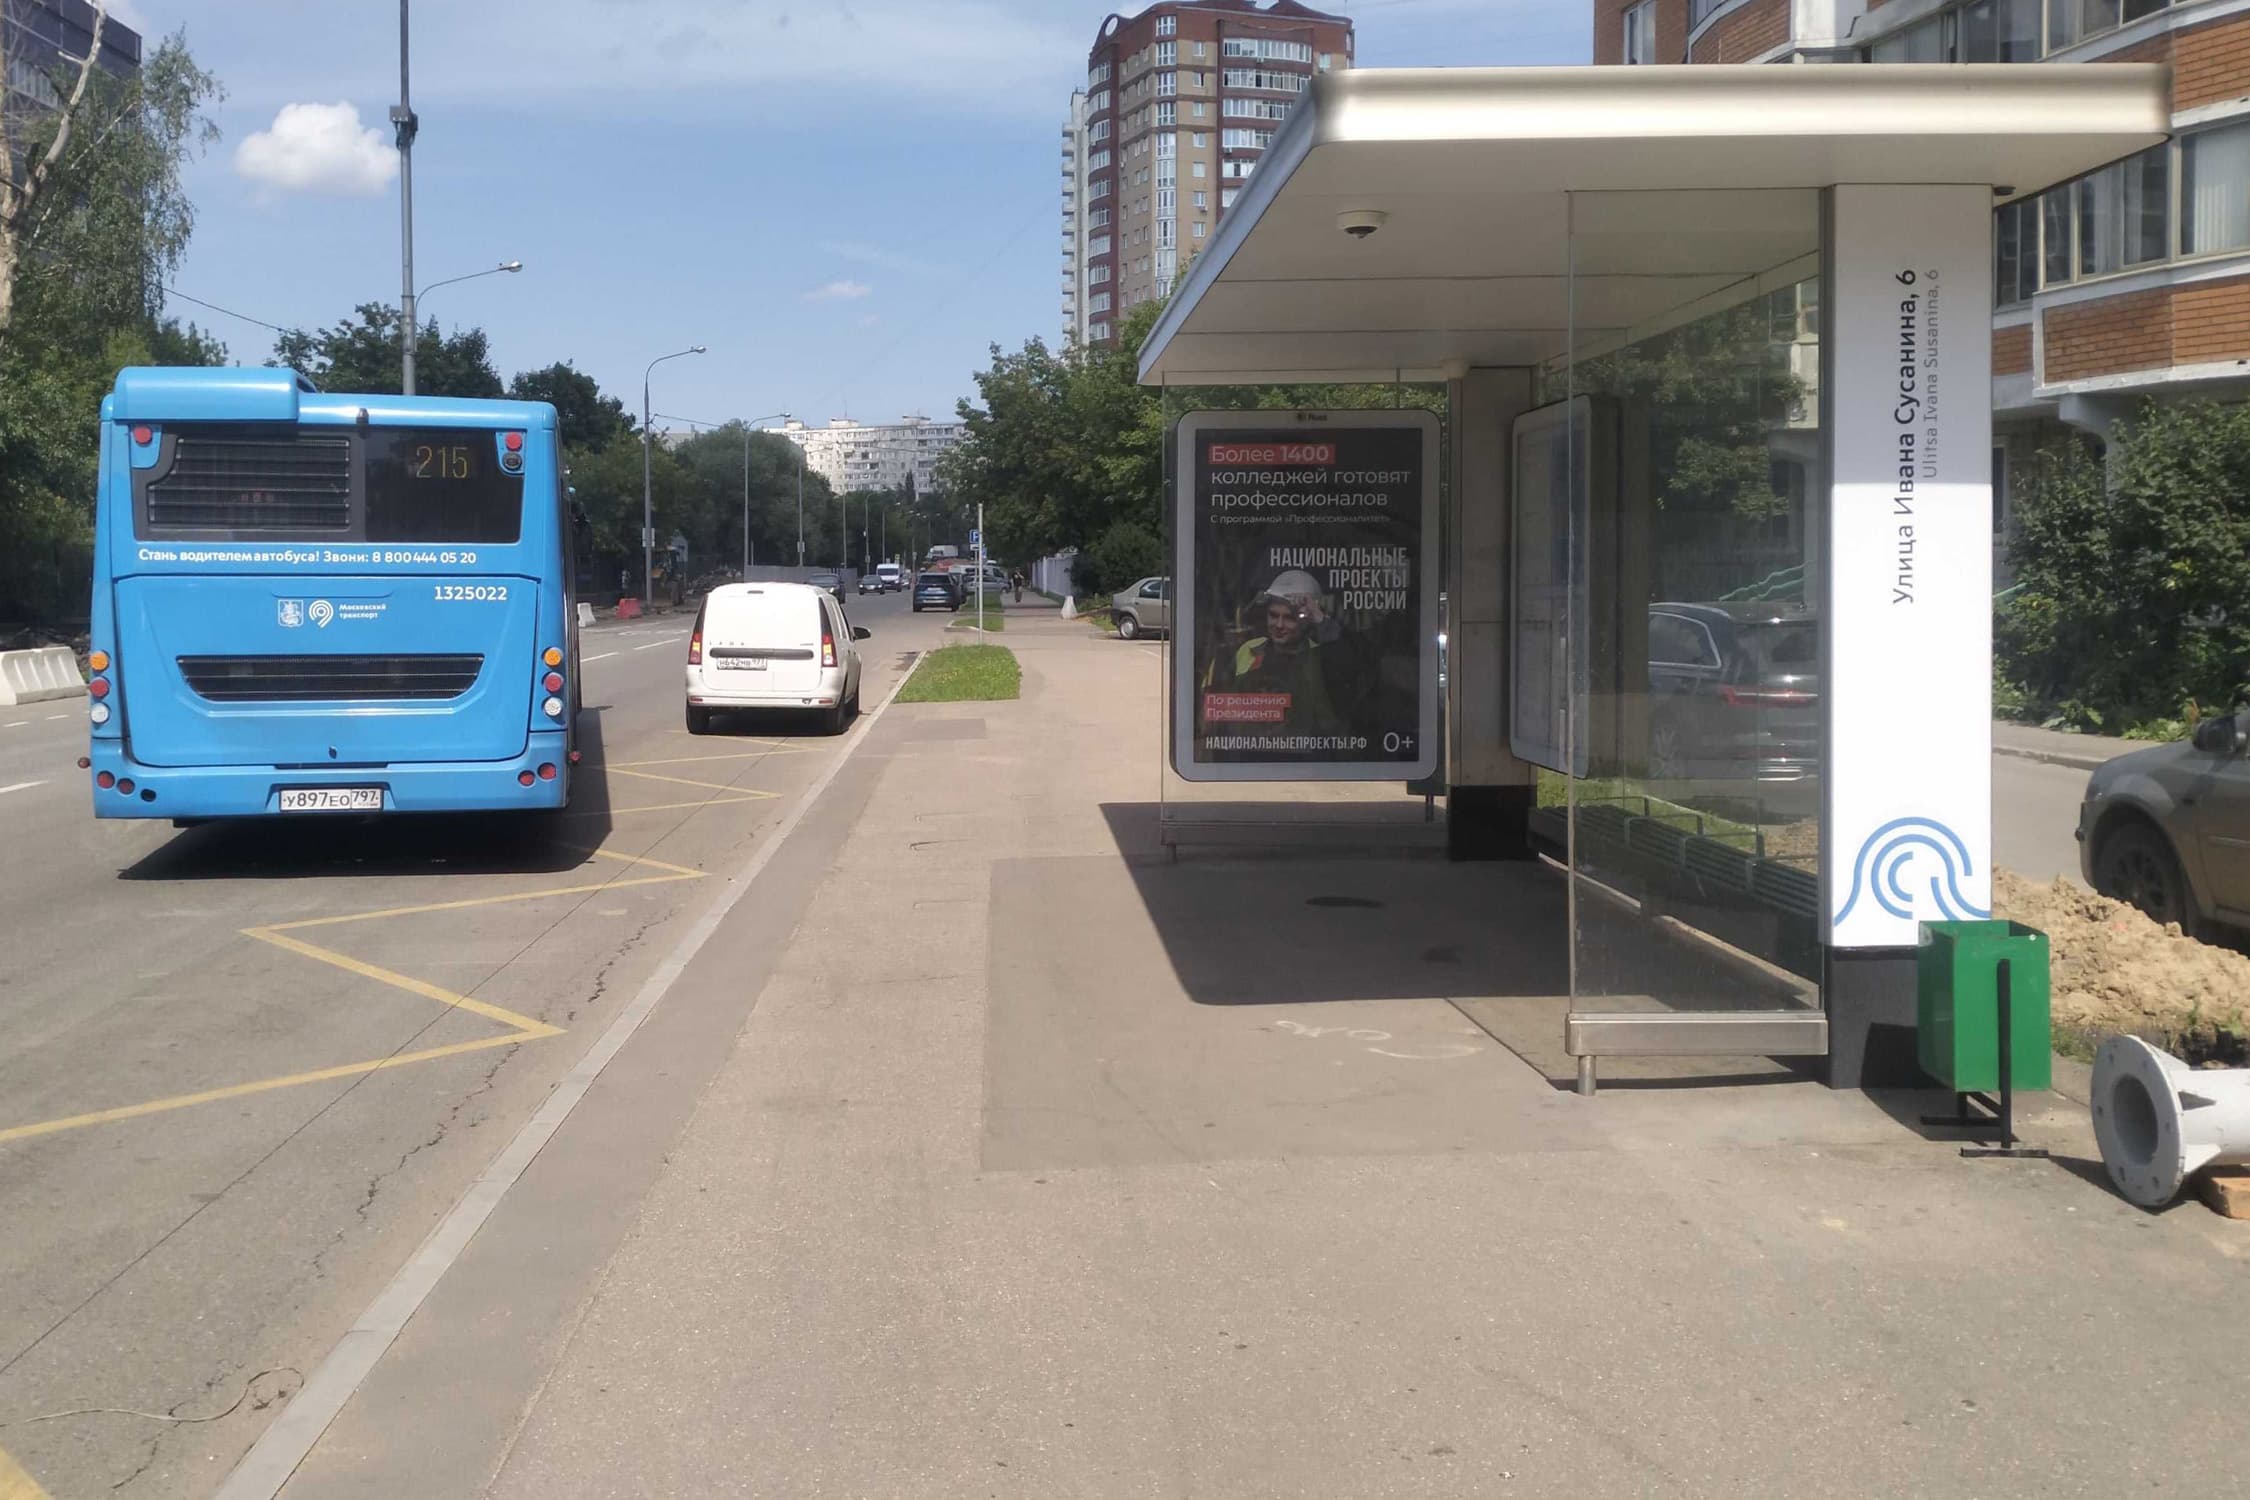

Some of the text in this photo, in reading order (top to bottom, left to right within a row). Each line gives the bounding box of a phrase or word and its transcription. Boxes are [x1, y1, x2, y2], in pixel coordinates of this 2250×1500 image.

[1922, 269, 1941, 479] Ulitsa Ivana Susanina, 6
[1893, 268, 1921, 605] Улица Ивана Сусанина, 6
[415, 445, 468, 479] 215
[1211, 446, 1329, 462] Более 1400
[1211, 468, 1411, 487] колледжей готовят
[1211, 490, 1388, 510] профессионалов
[1210, 515, 1218, 523] С
[1220, 513, 1282, 525] программой
[138, 548, 477, 564] Стань водителем автобуса! Звони: 8 800 444 05 20
[1270, 547, 1407, 569] НАЦИОНАЛЬНЫЕ
[1329, 569, 1407, 589] ПРОЕКТЫ
[434, 585, 508, 601] 1325022
[1343, 590, 1406, 610] РОССИИ
[1207, 695, 1287, 708] По решению
[1207, 708, 1281, 721] Президента
[1206, 735, 1367, 751] НАЦИОНАЛЬНЫЕПРОЕКТЫ.РФ
